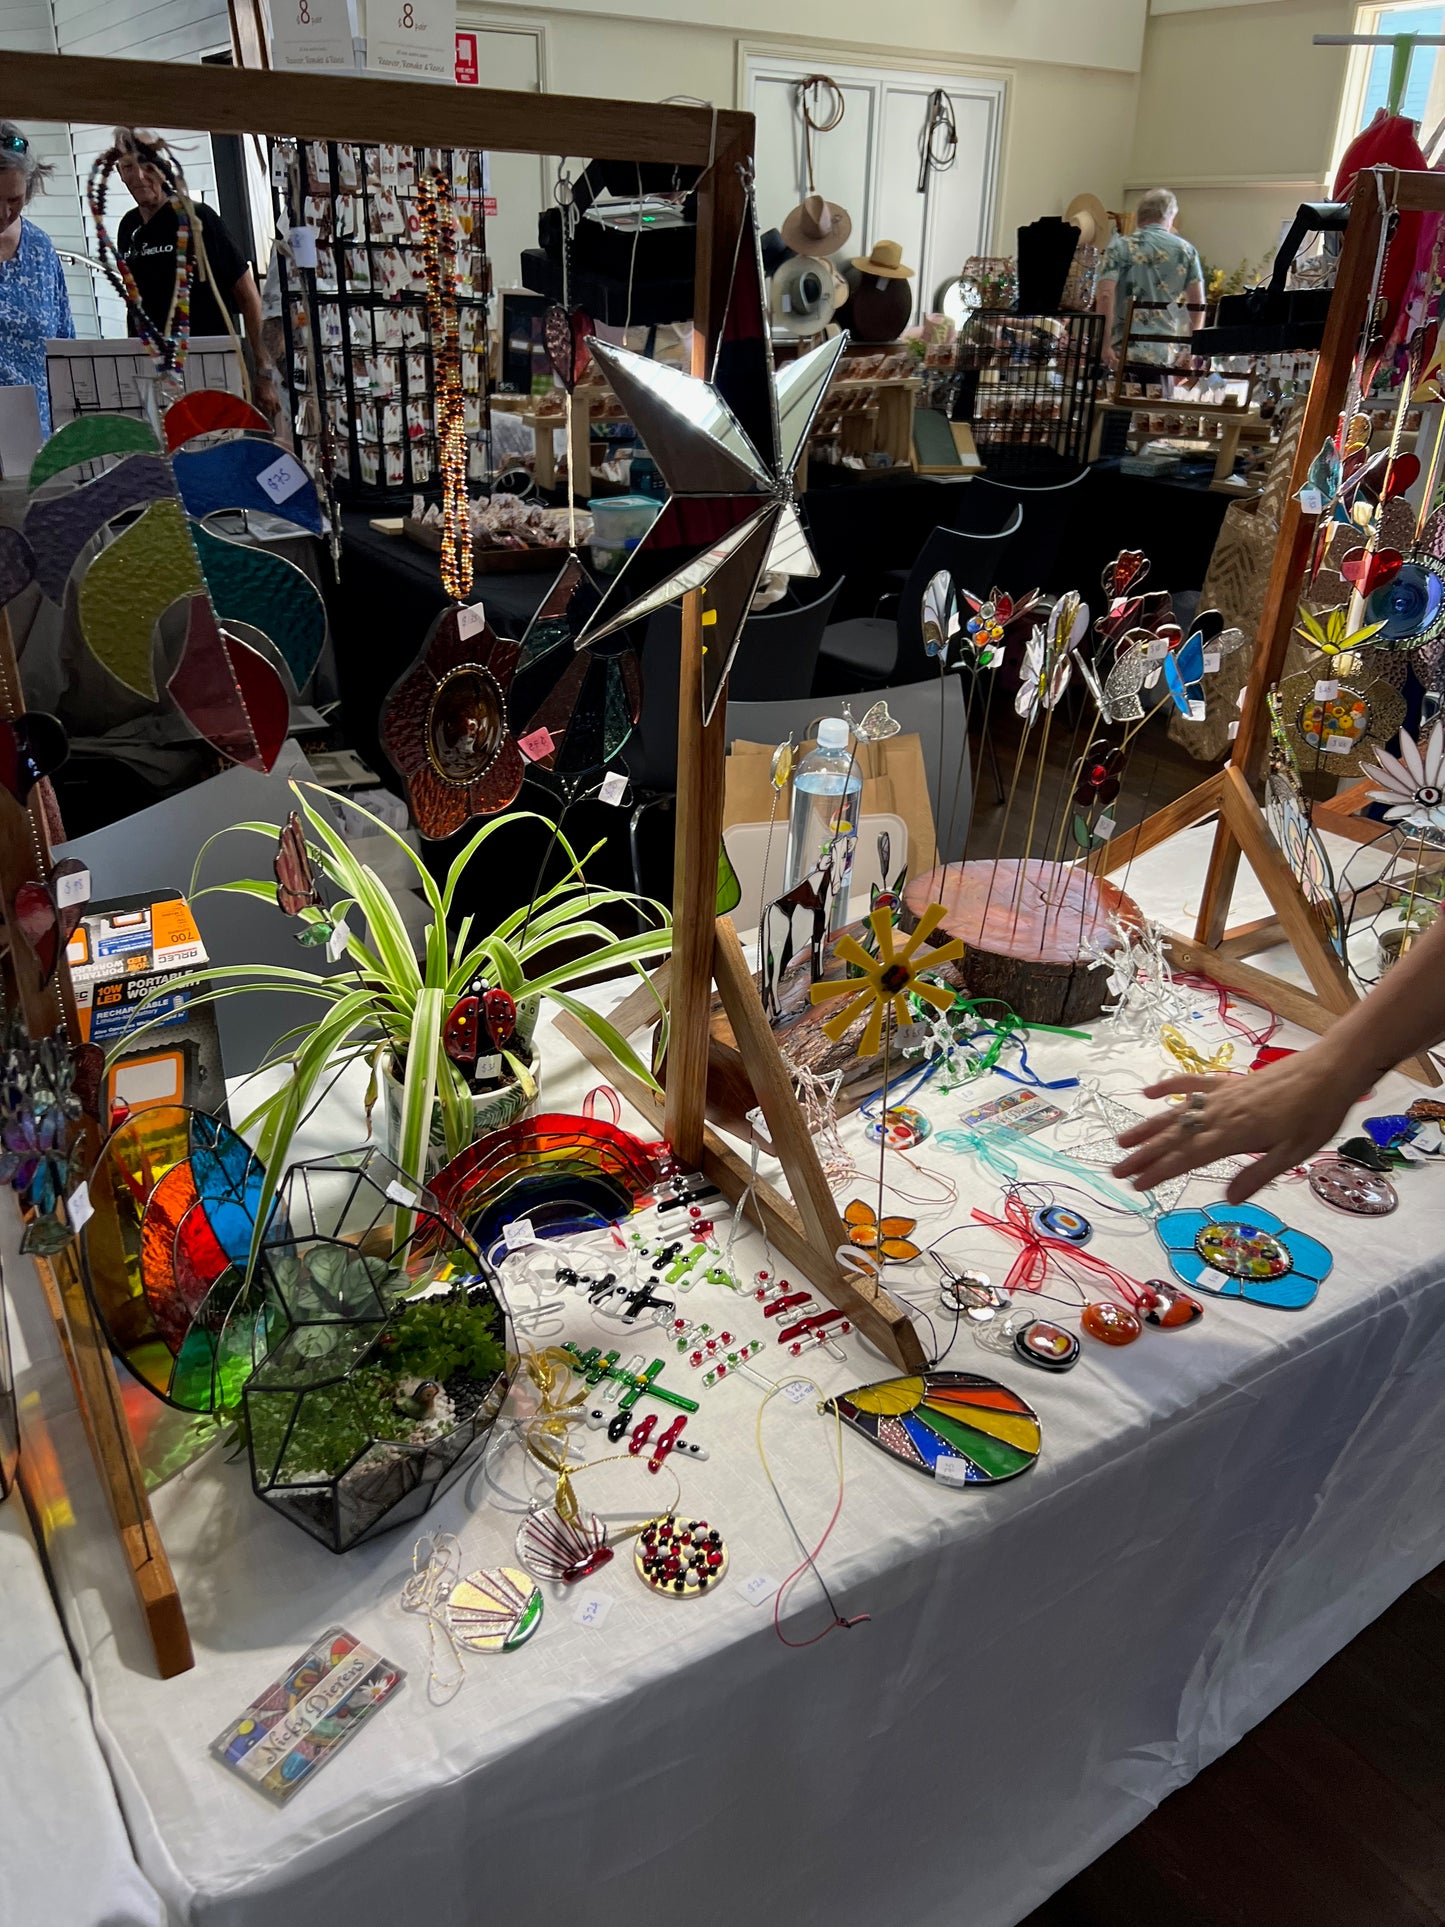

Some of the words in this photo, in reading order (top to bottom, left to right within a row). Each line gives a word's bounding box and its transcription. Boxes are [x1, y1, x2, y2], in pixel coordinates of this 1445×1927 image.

[171, 932, 195, 943] 700
[158, 951, 199, 964] ARLEC
[98, 983, 124, 996] 10W
[97, 993, 122, 1006] LED
[96, 999, 169, 1019] RECHARABLE
[261, 1717, 312, 1764] Nicky
[304, 1658, 365, 1720] Dierens
